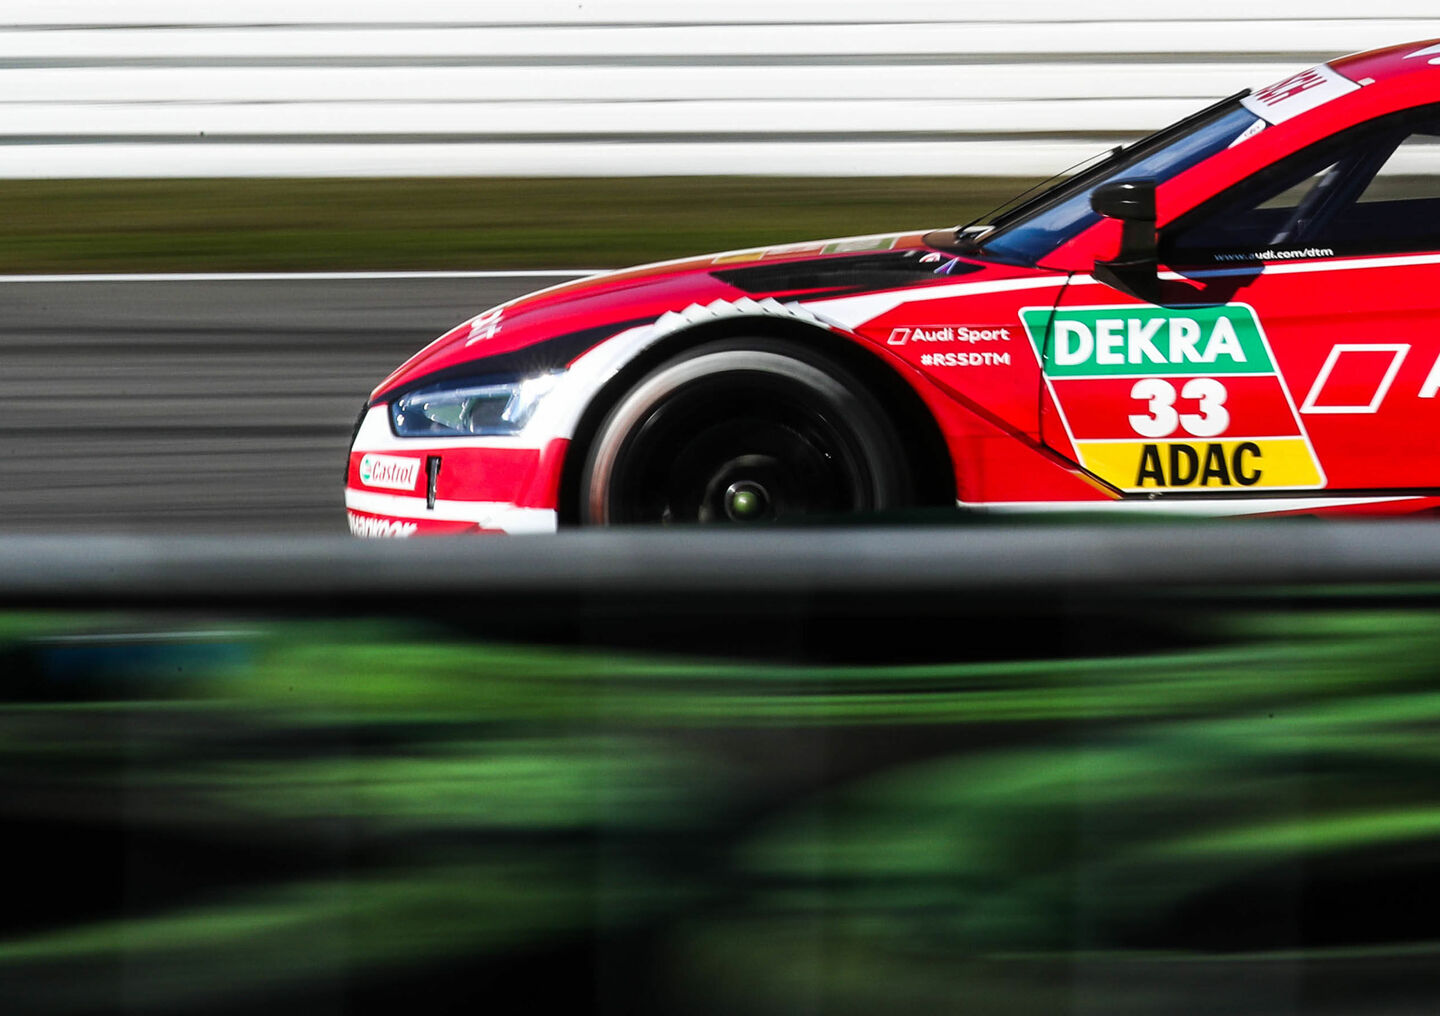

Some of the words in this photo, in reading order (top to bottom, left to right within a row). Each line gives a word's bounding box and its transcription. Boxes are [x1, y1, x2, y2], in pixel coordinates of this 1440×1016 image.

[911, 327, 954, 342] Audi
[957, 327, 1011, 344] Sport
[1053, 316, 1248, 367] DEKRA
[1127, 378, 1230, 438] 33
[372, 460, 414, 484] Castrol
[1135, 442, 1263, 487] ADAC
